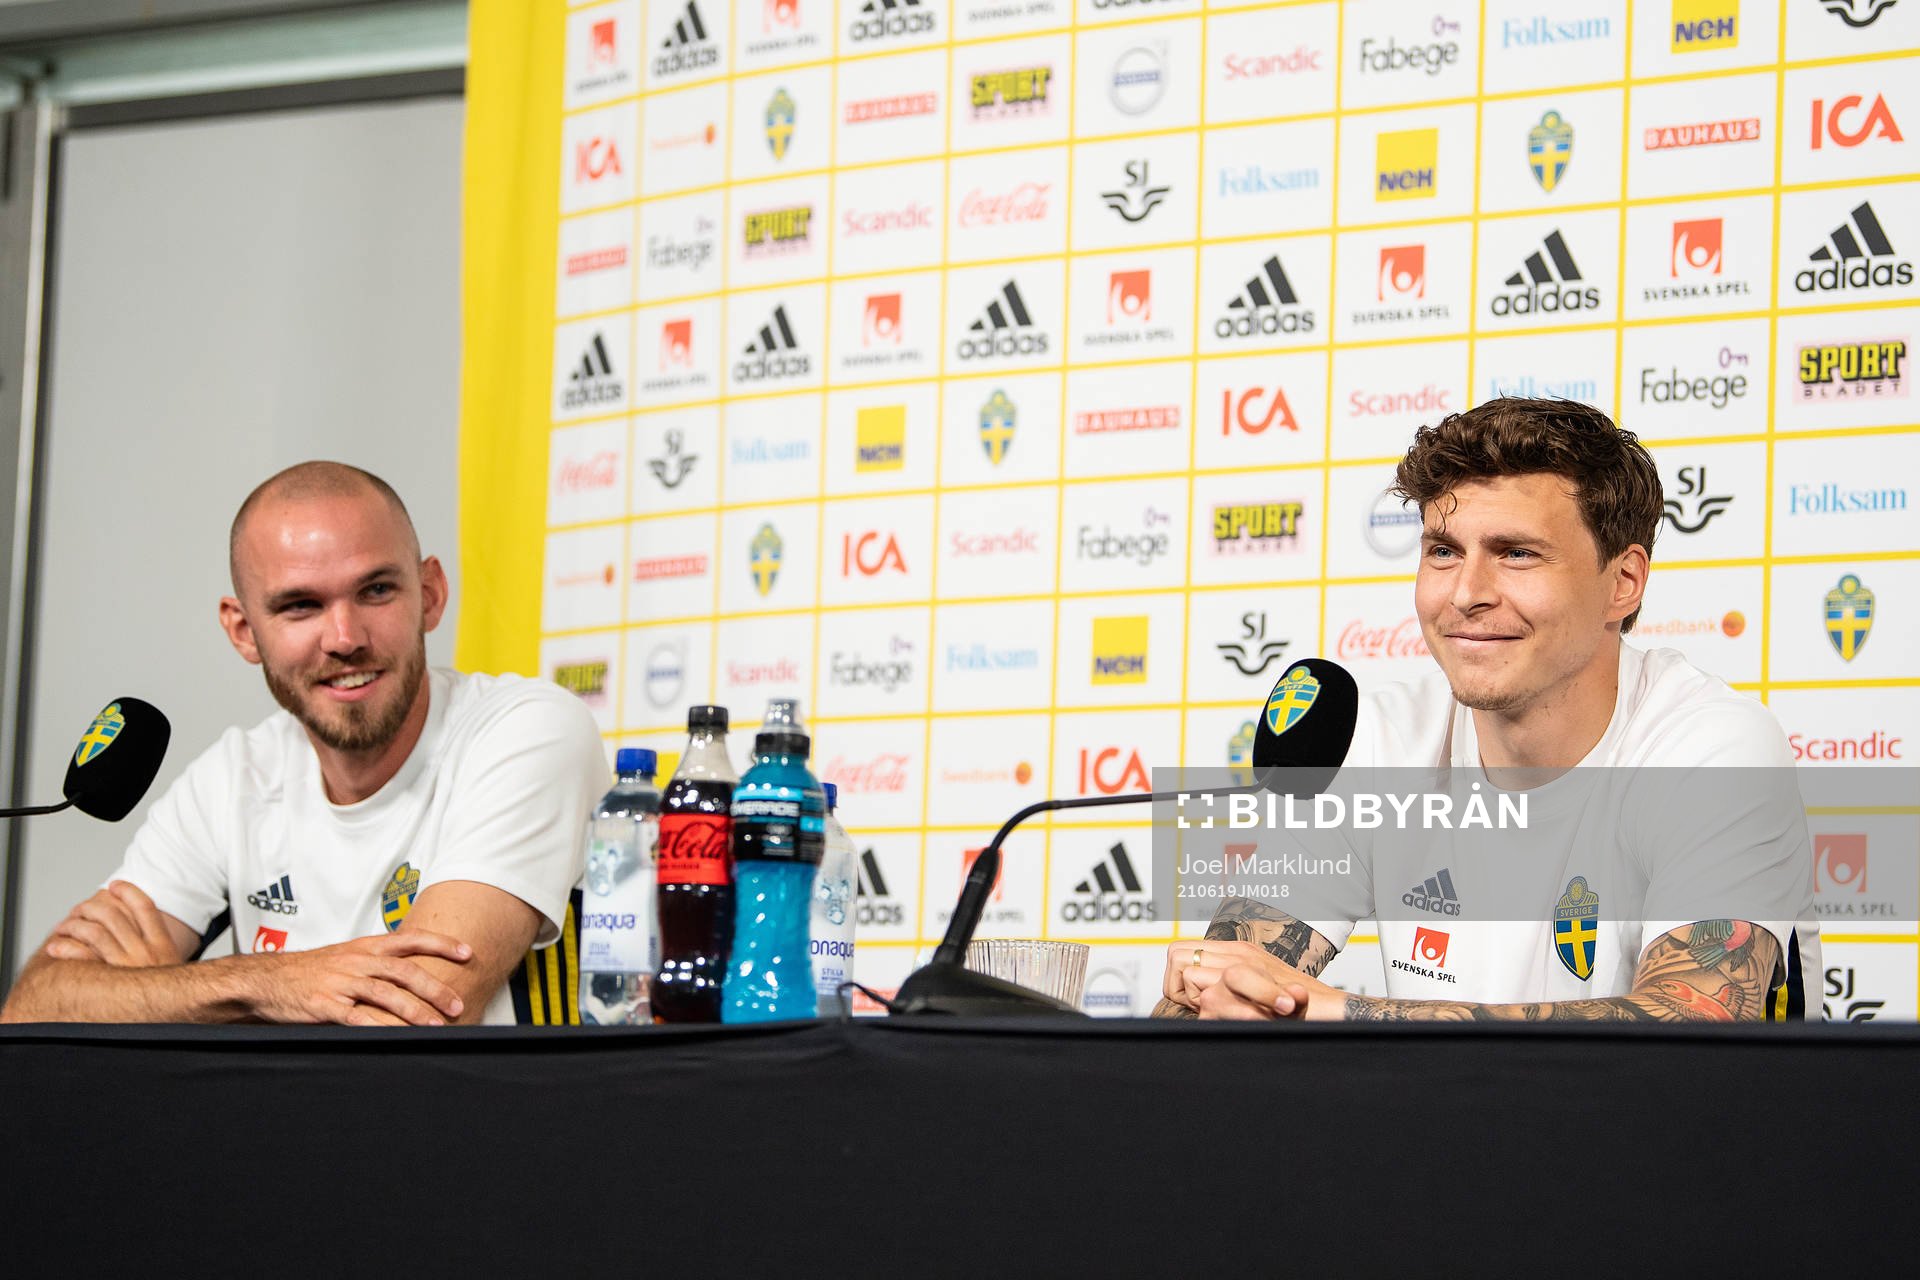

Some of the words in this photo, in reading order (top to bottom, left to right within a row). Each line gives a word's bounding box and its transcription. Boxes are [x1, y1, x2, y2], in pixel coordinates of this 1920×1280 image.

[850, 11, 935, 42] adidas
[1502, 16, 1610, 48] Folksam
[653, 44, 720, 78] adidas
[1224, 46, 1323, 80] Scandic
[1360, 35, 1459, 75] Fabege
[1646, 119, 1760, 150] BAUHAUS
[1810, 93, 1904, 150] ICA
[574, 135, 622, 183] ICA
[1125, 159, 1149, 188] SJ
[1219, 164, 1320, 198] Folksam
[843, 202, 933, 236] Scandic
[1644, 285, 1709, 301] SVENSKA
[1717, 281, 1750, 296] SPEL
[1795, 258, 1913, 293] adidas
[1420, 306, 1450, 320] SPEL
[1491, 284, 1600, 316] adidas
[1215, 307, 1315, 338] adidas
[958, 330, 1048, 361] adidas
[733, 348, 810, 383] adidas
[1800, 341, 1905, 383] SPORT
[1349, 384, 1448, 417] Scandic
[1641, 366, 1747, 409] Fabege
[1805, 381, 1901, 399] BLADET
[1222, 386, 1299, 436] ICA
[1678, 466, 1705, 496] SJ
[1790, 484, 1906, 514] Folksam
[1213, 502, 1301, 540] SPORT
[842, 531, 908, 577] ICA
[951, 528, 1038, 557] Scandic
[1077, 525, 1169, 565] Fabege
[1242, 612, 1266, 640] SJ
[1337, 616, 1431, 660] Coca-Co
[1789, 732, 1902, 761] Scandic
[1079, 746, 1153, 795] ICA
[247, 894, 298, 915] adidas
[1061, 892, 1158, 923] adidas
[1401, 892, 1461, 917] adidas
[1560, 906, 1593, 917] SVERIGE
[1814, 903, 1855, 915] NSKA
[1861, 903, 1896, 915] SPEL
[1392, 959, 1434, 979] SVENSKA
[1437, 972, 1457, 984] SPEL
[1824, 967, 1854, 1000] SJ
